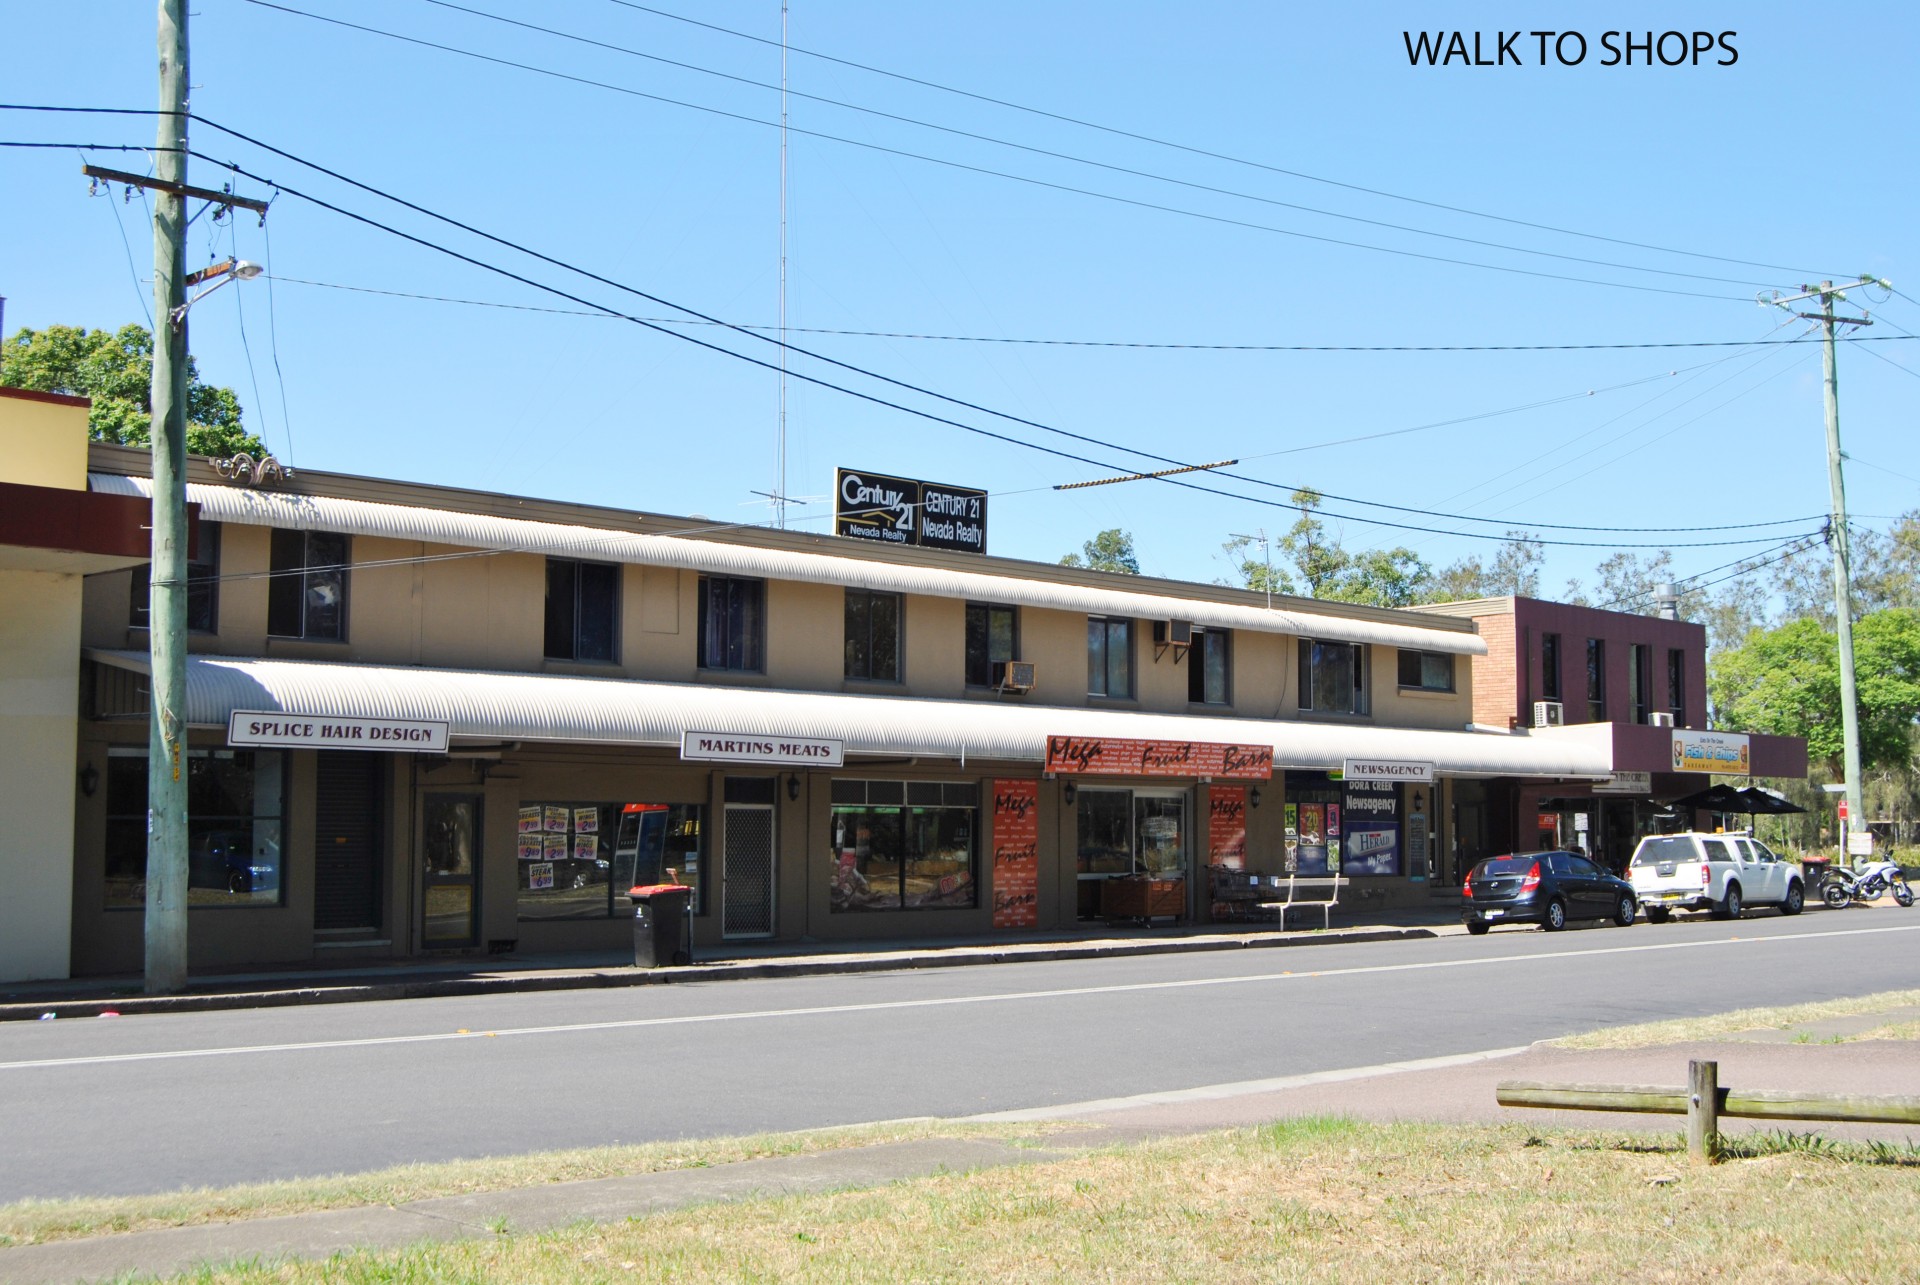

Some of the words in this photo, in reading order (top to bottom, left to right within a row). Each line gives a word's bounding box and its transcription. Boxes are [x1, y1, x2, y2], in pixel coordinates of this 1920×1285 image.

[841, 474, 904, 512] Century
[925, 491, 968, 517] CENTURY
[970, 498, 980, 519] 21
[895, 503, 914, 531] 21
[849, 524, 880, 538] Nevada
[882, 528, 907, 543] Realty
[922, 516, 954, 541] Nevada
[956, 521, 983, 548] Realty
[250, 721, 314, 738] SPLICE
[321, 724, 363, 740] HAIR
[369, 726, 433, 742] DESIGN
[699, 739, 774, 755] MARTINS
[779, 743, 831, 758] MEATS
[1048, 737, 1103, 772] Mega
[1141, 743, 1192, 773] Fruit
[1221, 745, 1272, 774] Barn
[1684, 743, 1705, 759] Fish
[1705, 745, 1713, 759] &
[1714, 746, 1739, 762] Chips
[1353, 764, 1426, 775] NEWSAGENCY
[1349, 781, 1370, 791] DORA
[1372, 781, 1394, 791] CREEK
[995, 794, 1035, 819] Mega
[1210, 799, 1243, 821] Mega
[1346, 795, 1397, 814] Newsagency
[1285, 810, 1296, 826] 15
[1360, 833, 1390, 851] HERALD
[994, 842, 1036, 867] Fruit
[1367, 856, 1376, 867] My
[531, 867, 553, 877] STEAK
[993, 891, 1036, 912] Barn
